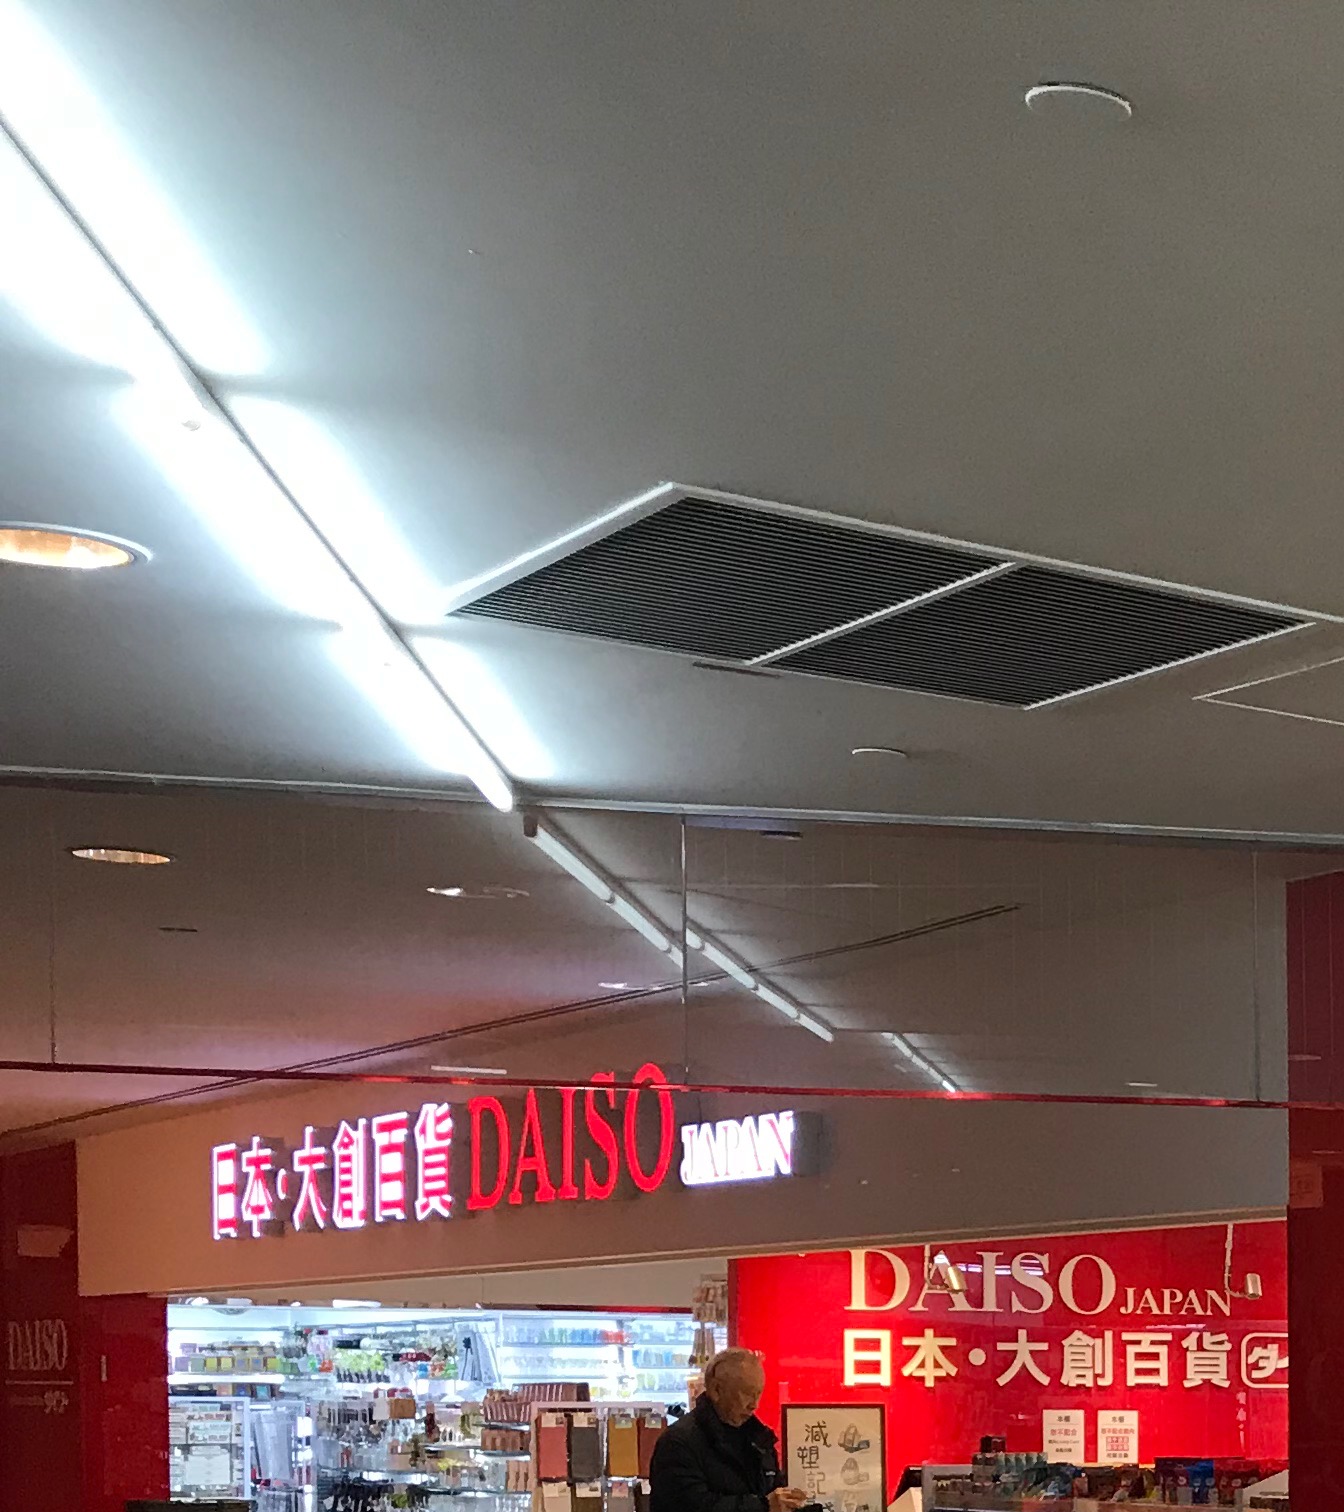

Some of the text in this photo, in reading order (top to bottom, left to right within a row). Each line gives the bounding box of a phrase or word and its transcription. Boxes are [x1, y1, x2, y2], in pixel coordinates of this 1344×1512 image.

[467, 1062, 677, 1211] DAISO
[680, 1110, 797, 1186] JAPAN
[843, 1248, 1232, 1317] DAISO JAPAN
